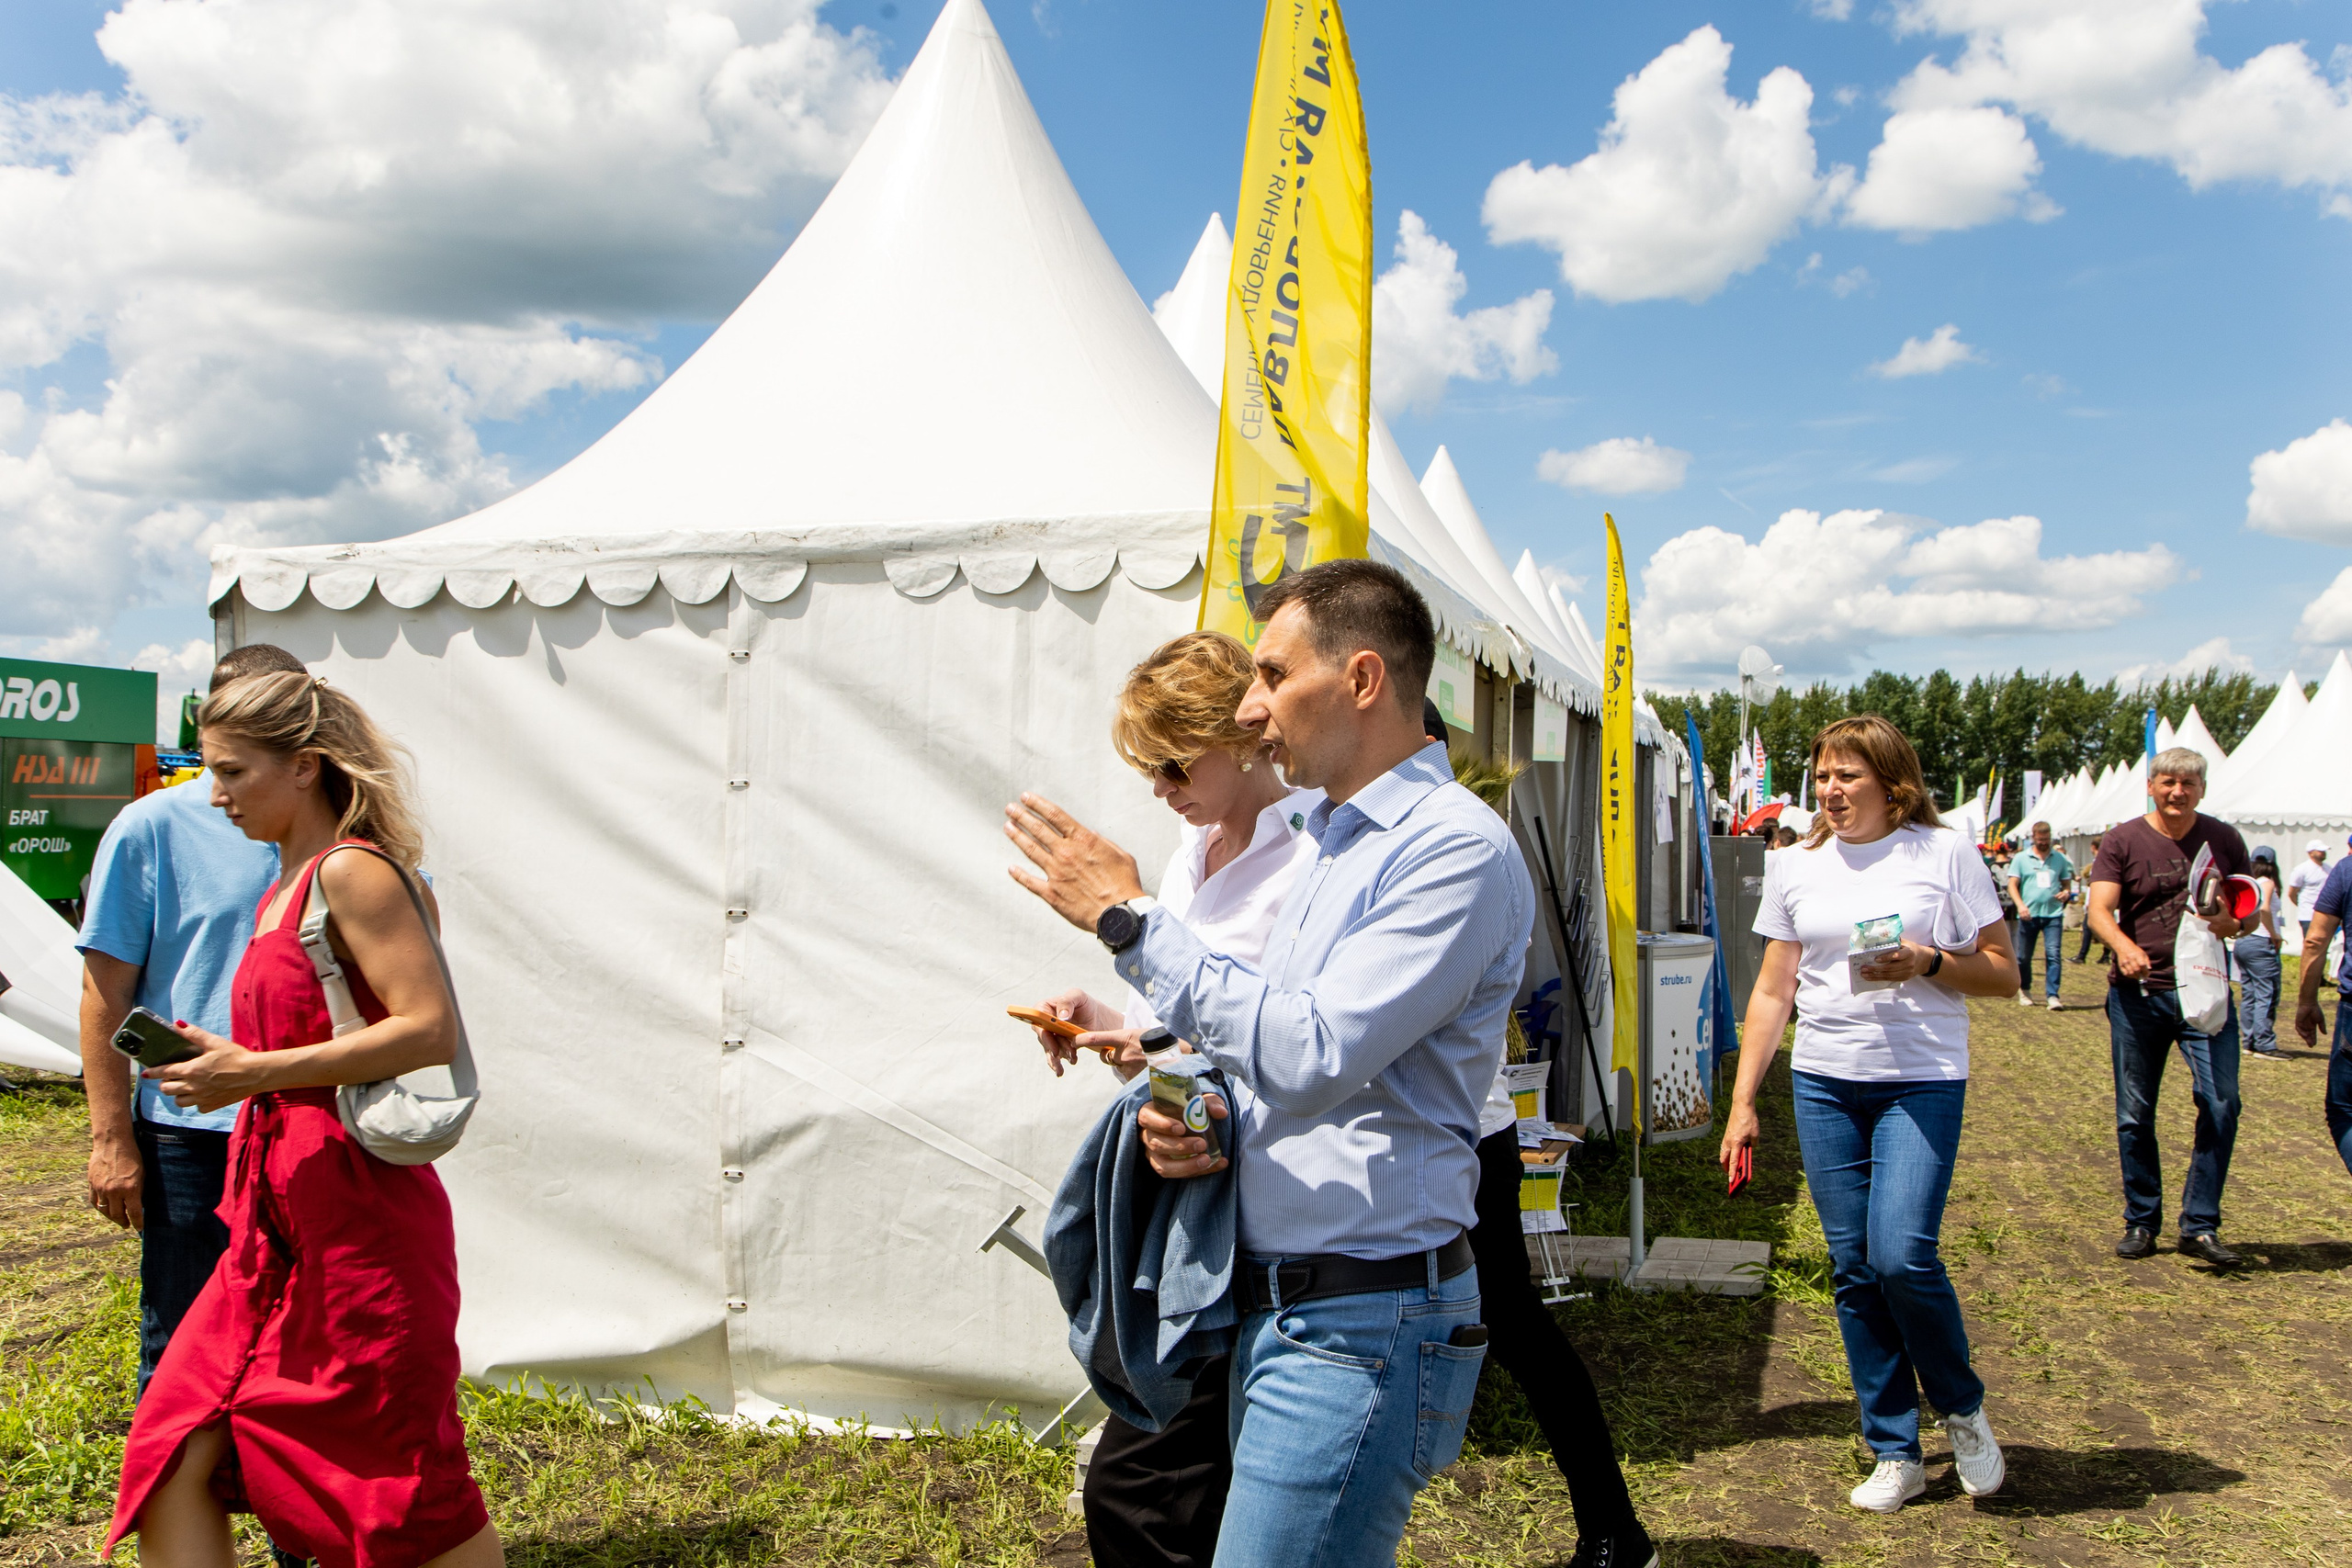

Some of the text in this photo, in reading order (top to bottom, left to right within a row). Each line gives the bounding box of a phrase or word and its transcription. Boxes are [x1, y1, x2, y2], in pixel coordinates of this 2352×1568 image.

[0, 676, 80, 722] ROS
[8, 809, 50, 826] БРАТ
[8, 837, 72, 853] «ОРОШ»
[1659, 974, 1692, 986] strube.ru
